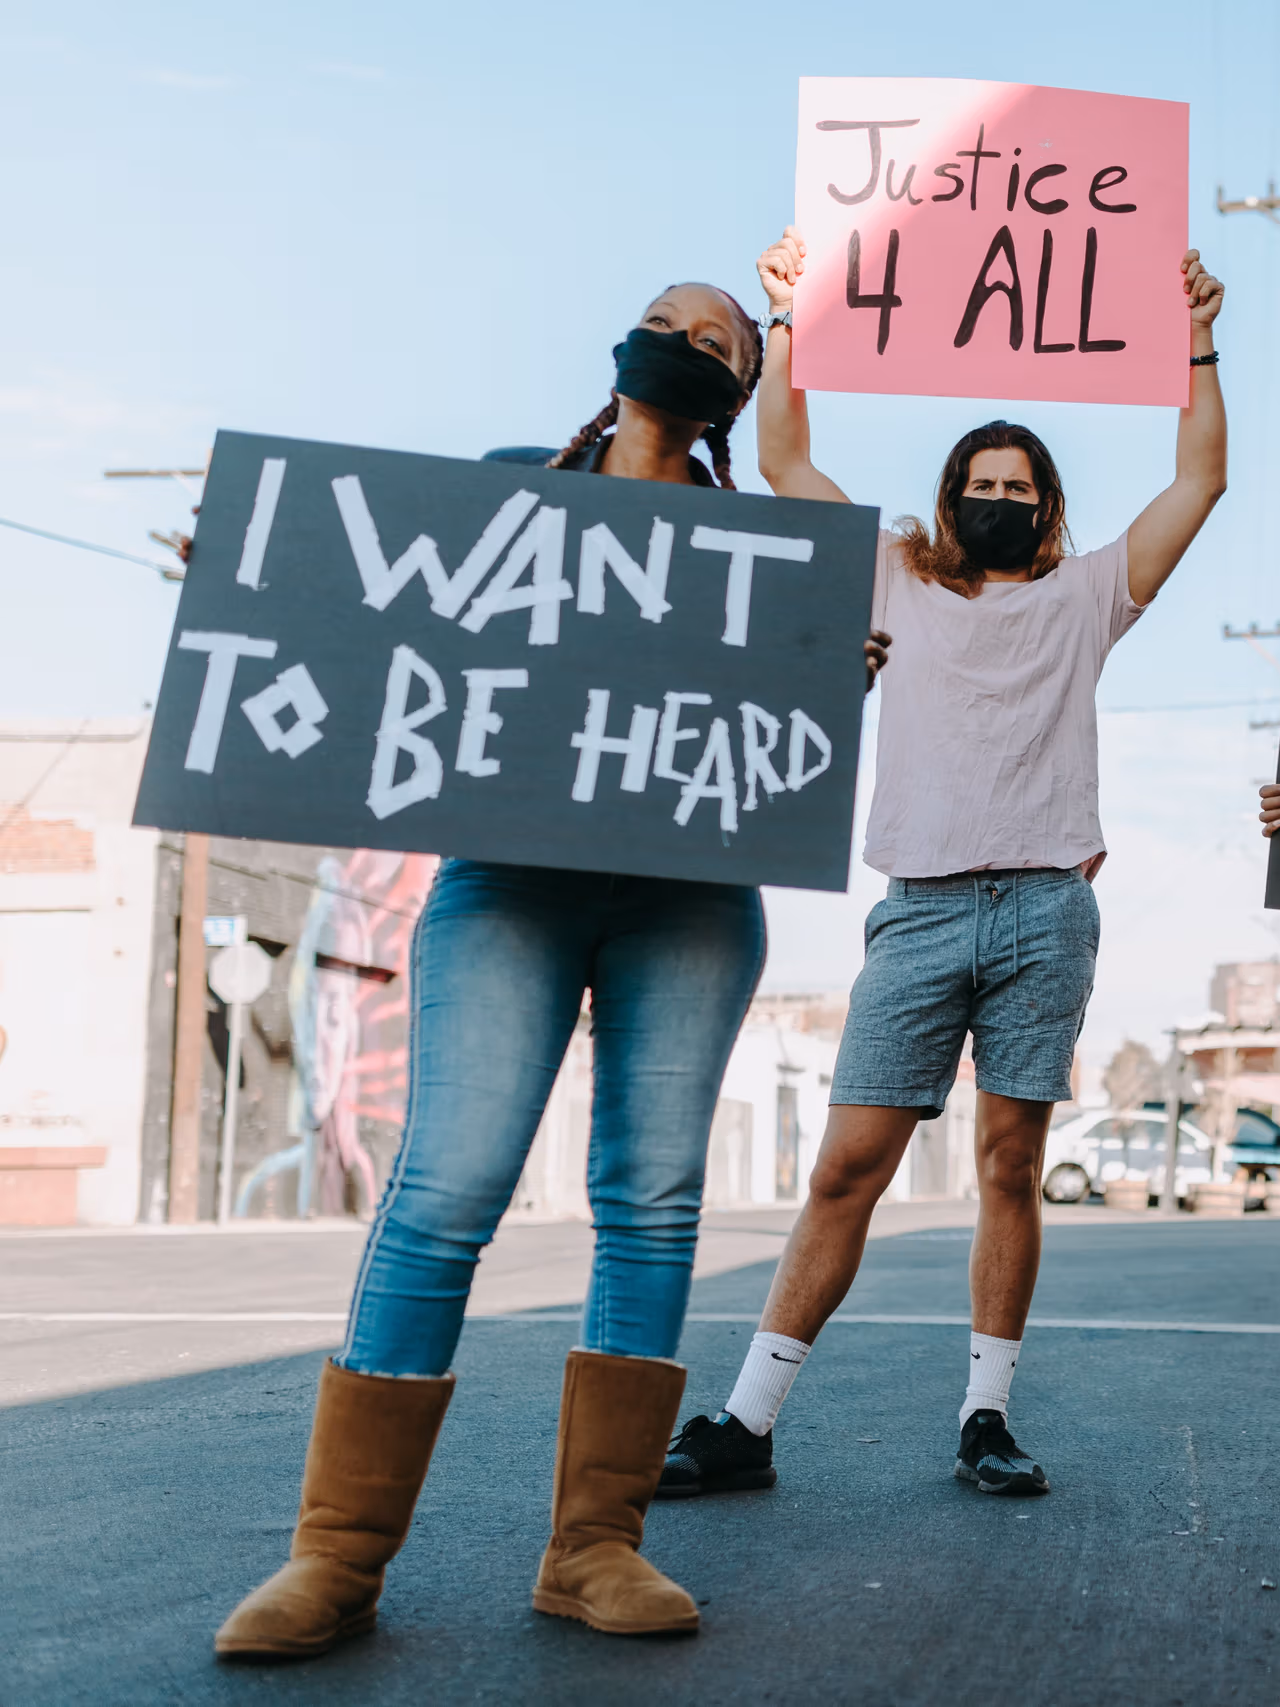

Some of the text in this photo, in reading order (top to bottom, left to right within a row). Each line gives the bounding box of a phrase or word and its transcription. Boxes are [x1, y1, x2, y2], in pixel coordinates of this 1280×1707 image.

[815, 118, 1138, 215] Justice
[846, 225, 1127, 356] 4 ALL
[236, 458, 815, 647] I WANT
[177, 631, 833, 836] TO BE HEARD
